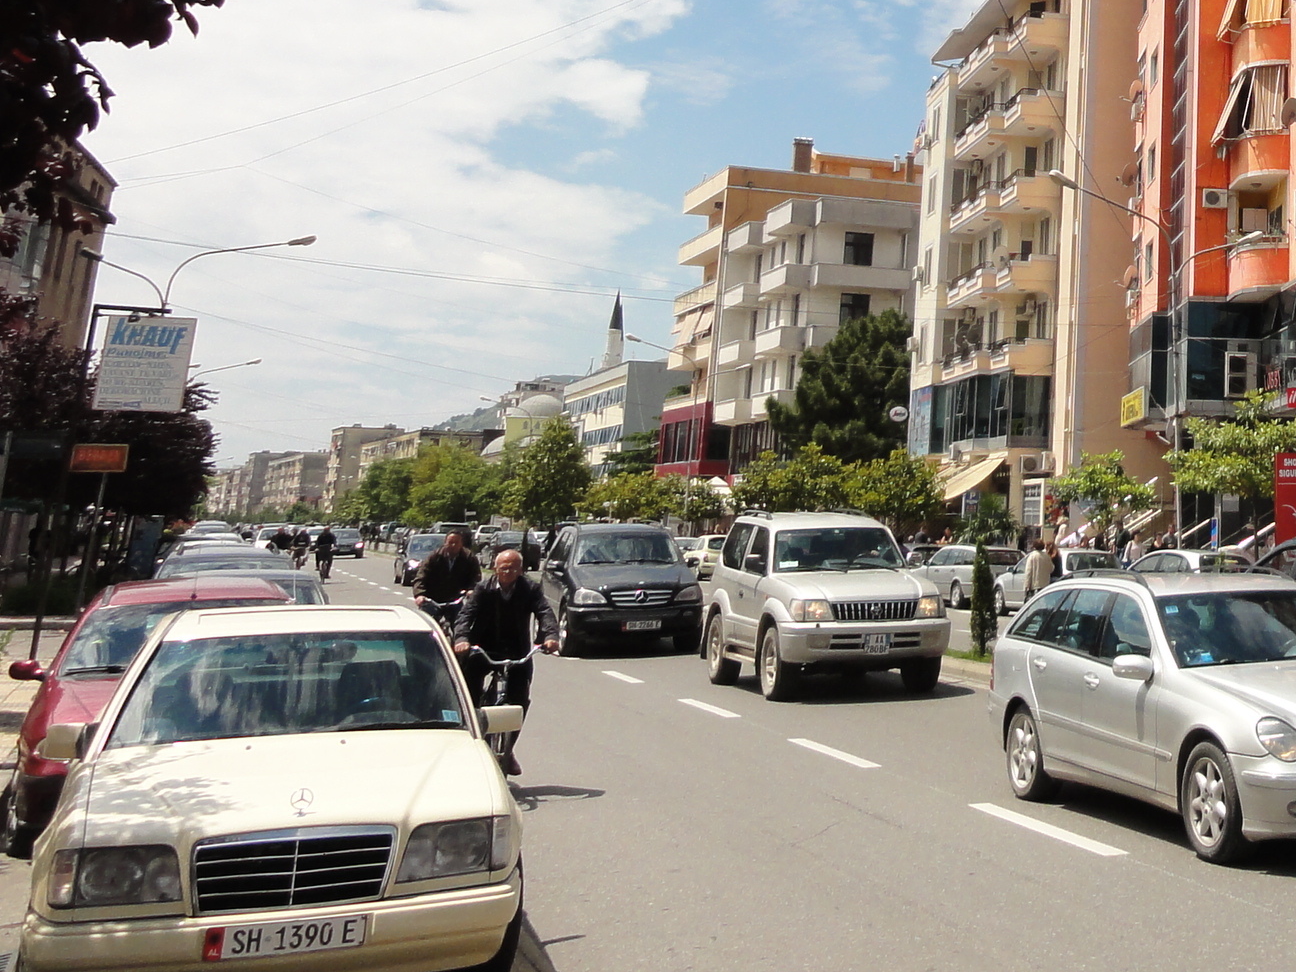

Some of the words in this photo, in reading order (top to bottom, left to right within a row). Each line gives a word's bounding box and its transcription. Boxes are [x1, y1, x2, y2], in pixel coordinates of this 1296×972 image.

[231, 928, 263, 954] SH
[274, 921, 334, 951] 1390
[341, 919, 358, 944] E
[207, 948, 219, 956] AL
